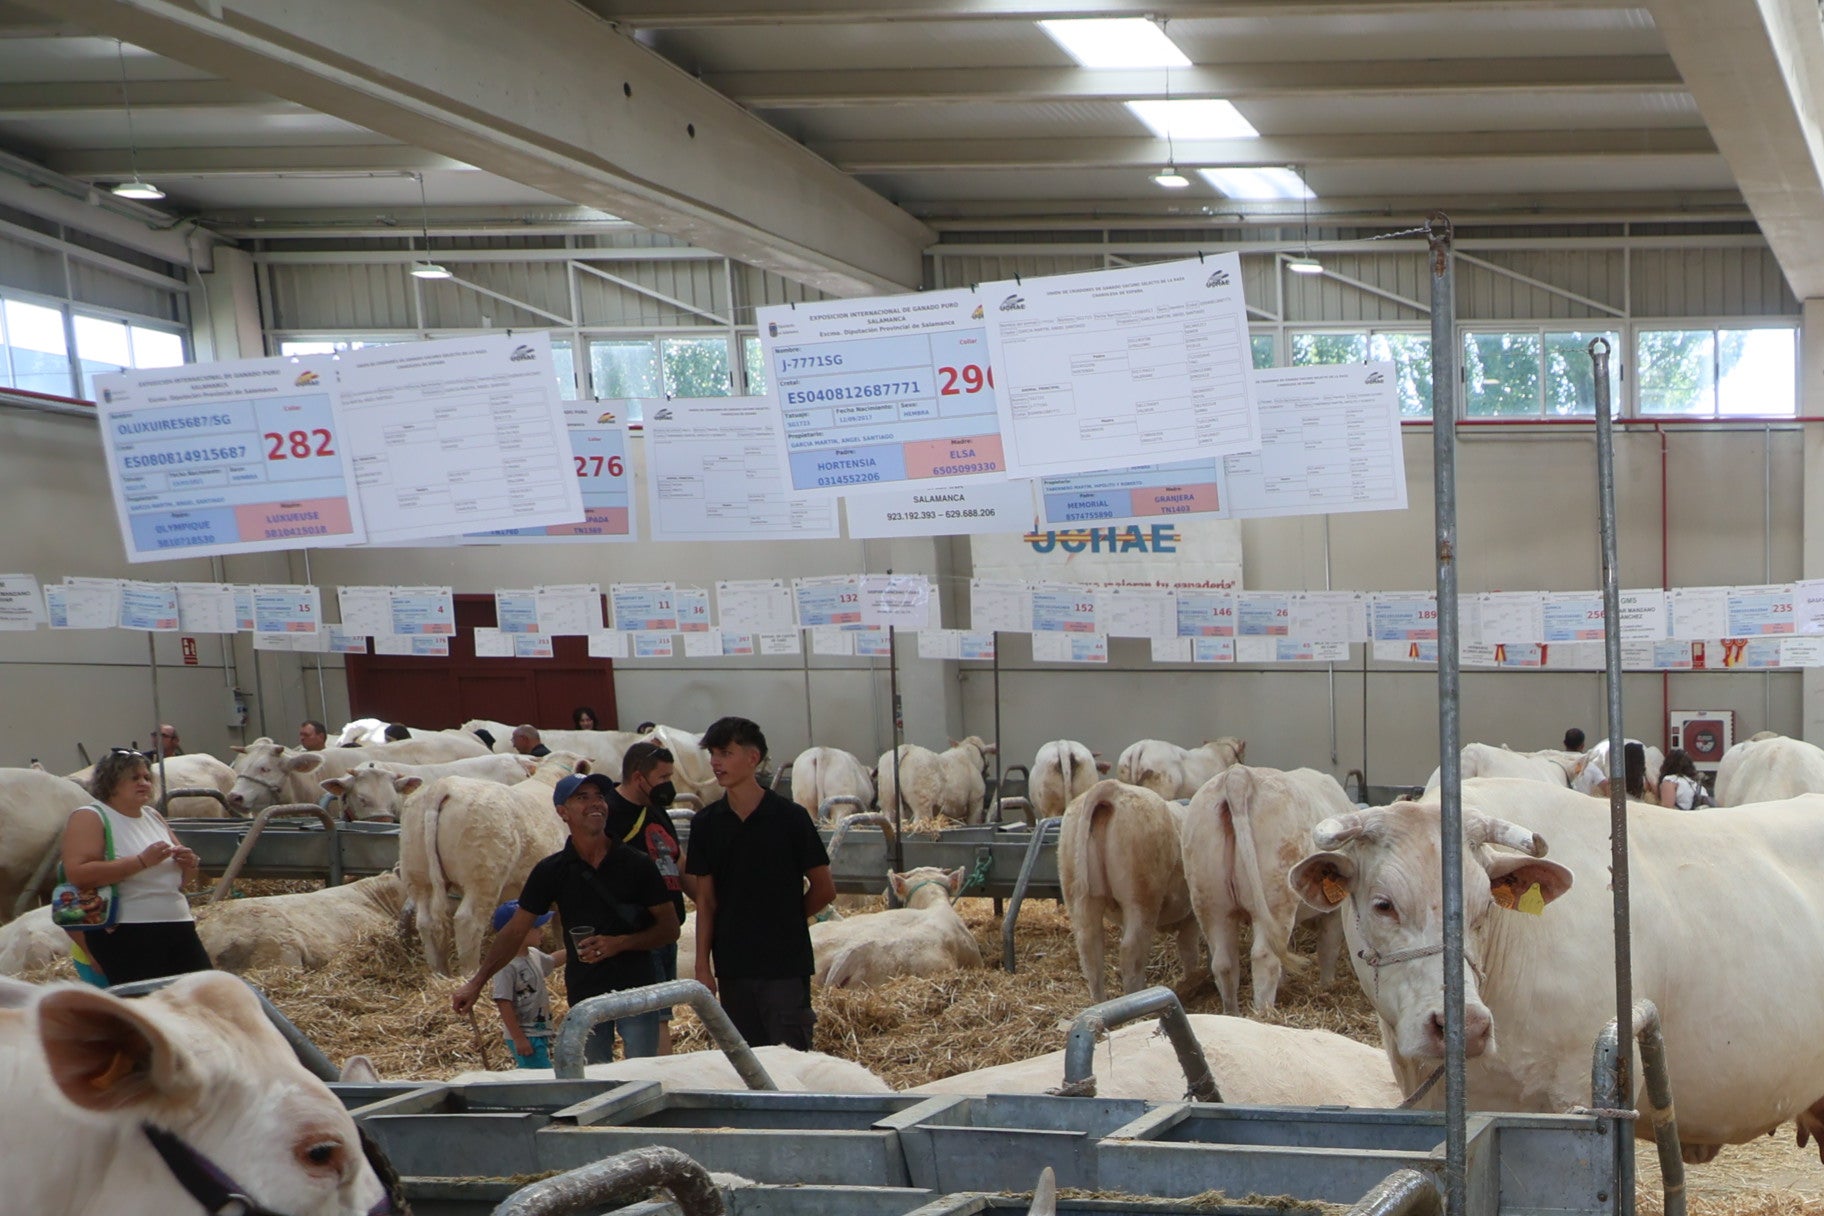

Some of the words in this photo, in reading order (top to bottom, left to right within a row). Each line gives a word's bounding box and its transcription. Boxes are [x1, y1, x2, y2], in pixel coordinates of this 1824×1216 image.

[809, 312, 849, 321] EXPOSICION
[850, 308, 901, 317] INTERNACIONAL
[912, 304, 940, 312] GANADO
[867, 316, 906, 325] SALAMANCA
[879, 324, 911, 332] Provincial
[921, 320, 955, 328] Salamanca
[782, 354, 843, 372] J-7771SG
[938, 363, 995, 395] 29
[787, 381, 920, 405] ES040812687771
[903, 409, 929, 417] HEMBRA
[863, 433, 894, 441] SANTIAGO
[263, 428, 335, 461] 282
[951, 438, 973, 446] Madre:
[125, 446, 247, 469] ES080814915687
[949, 449, 976, 459] ELSA
[573, 455, 624, 478] 276
[817, 458, 877, 471] HORTENSIA
[817, 473, 880, 486] 0314552206
[912, 494, 966, 504] SALAMANCA
[1154, 494, 1195, 503] GRANJERA
[1067, 500, 1109, 510] MEMORIAL
[1160, 505, 1191, 513] TN1403
[887, 510, 937, 521] 923.192.393
[945, 508, 996, 519] 629.688.206
[1030, 523, 1177, 554] UCHAE
[840, 594, 859, 603] 132
[298, 604, 311, 613] 15
[437, 605, 444, 614] 4
[658, 601, 670, 610] 11
[1075, 603, 1094, 612] 152
[1773, 604, 1792, 613] 235
[1212, 607, 1232, 616] 146
[1418, 610, 1438, 619] 189
[1587, 610, 1606, 619] 256
